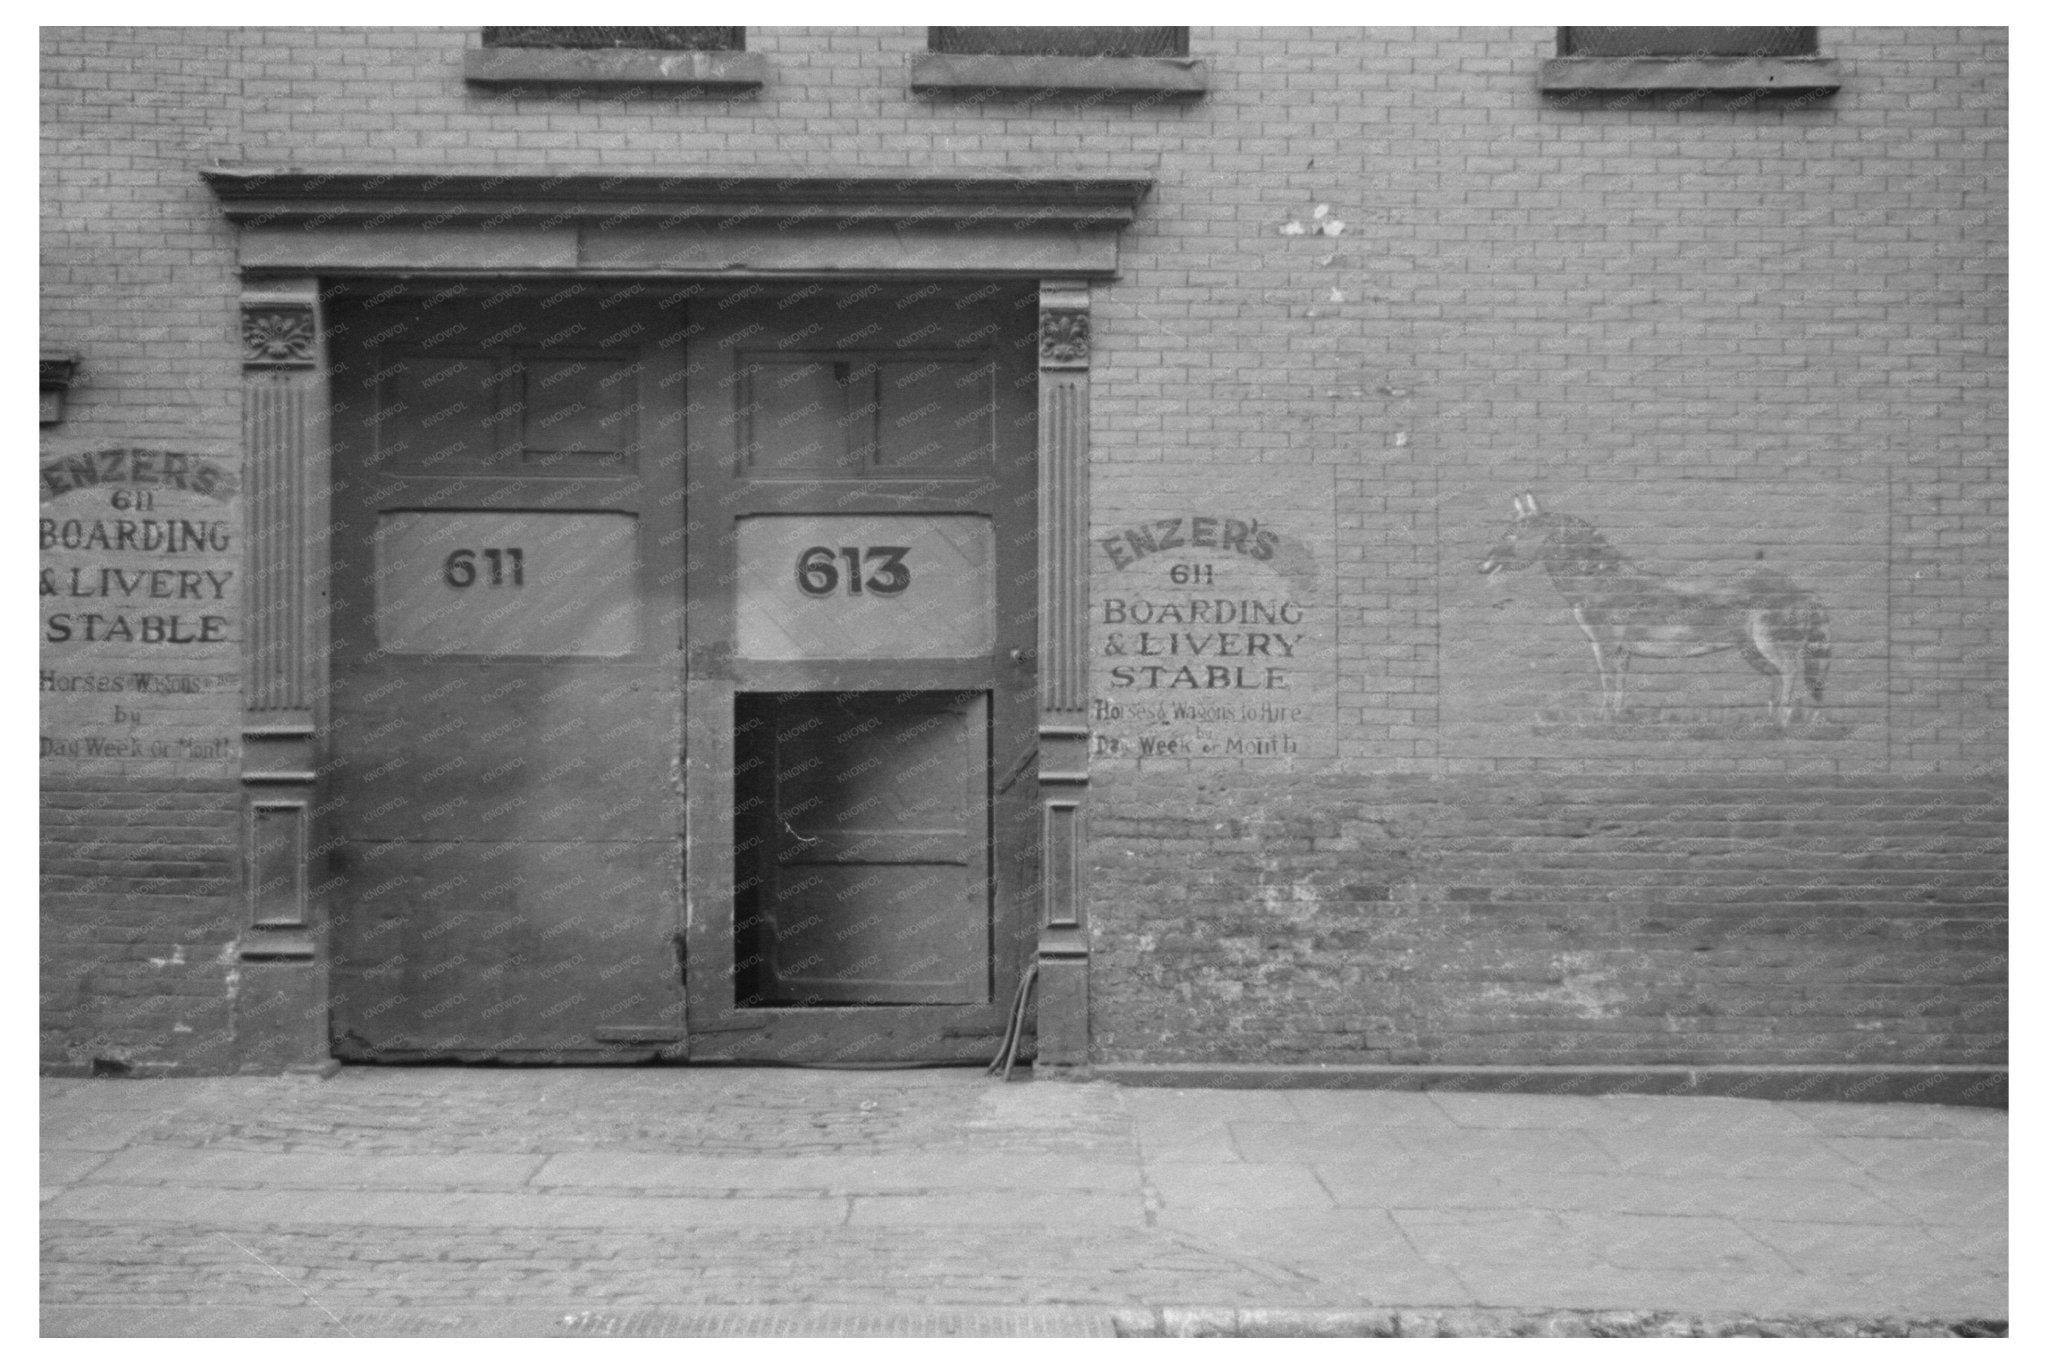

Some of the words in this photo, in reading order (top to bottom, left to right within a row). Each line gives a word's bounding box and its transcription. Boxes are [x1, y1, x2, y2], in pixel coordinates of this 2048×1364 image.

[40, 518, 230, 552] BOARDING
[1101, 516, 1280, 571] ENZER'S
[70, 567, 233, 599] LIVERY
[447, 548, 524, 588] 611
[795, 546, 912, 598] 613
[1170, 563, 1214, 585] 611
[1103, 599, 1303, 625] BOARDING
[46, 613, 227, 644] STABLE
[1104, 632, 1127, 656] &
[1139, 631, 1303, 658] LIVERY
[1110, 664, 1290, 690] STABLE
